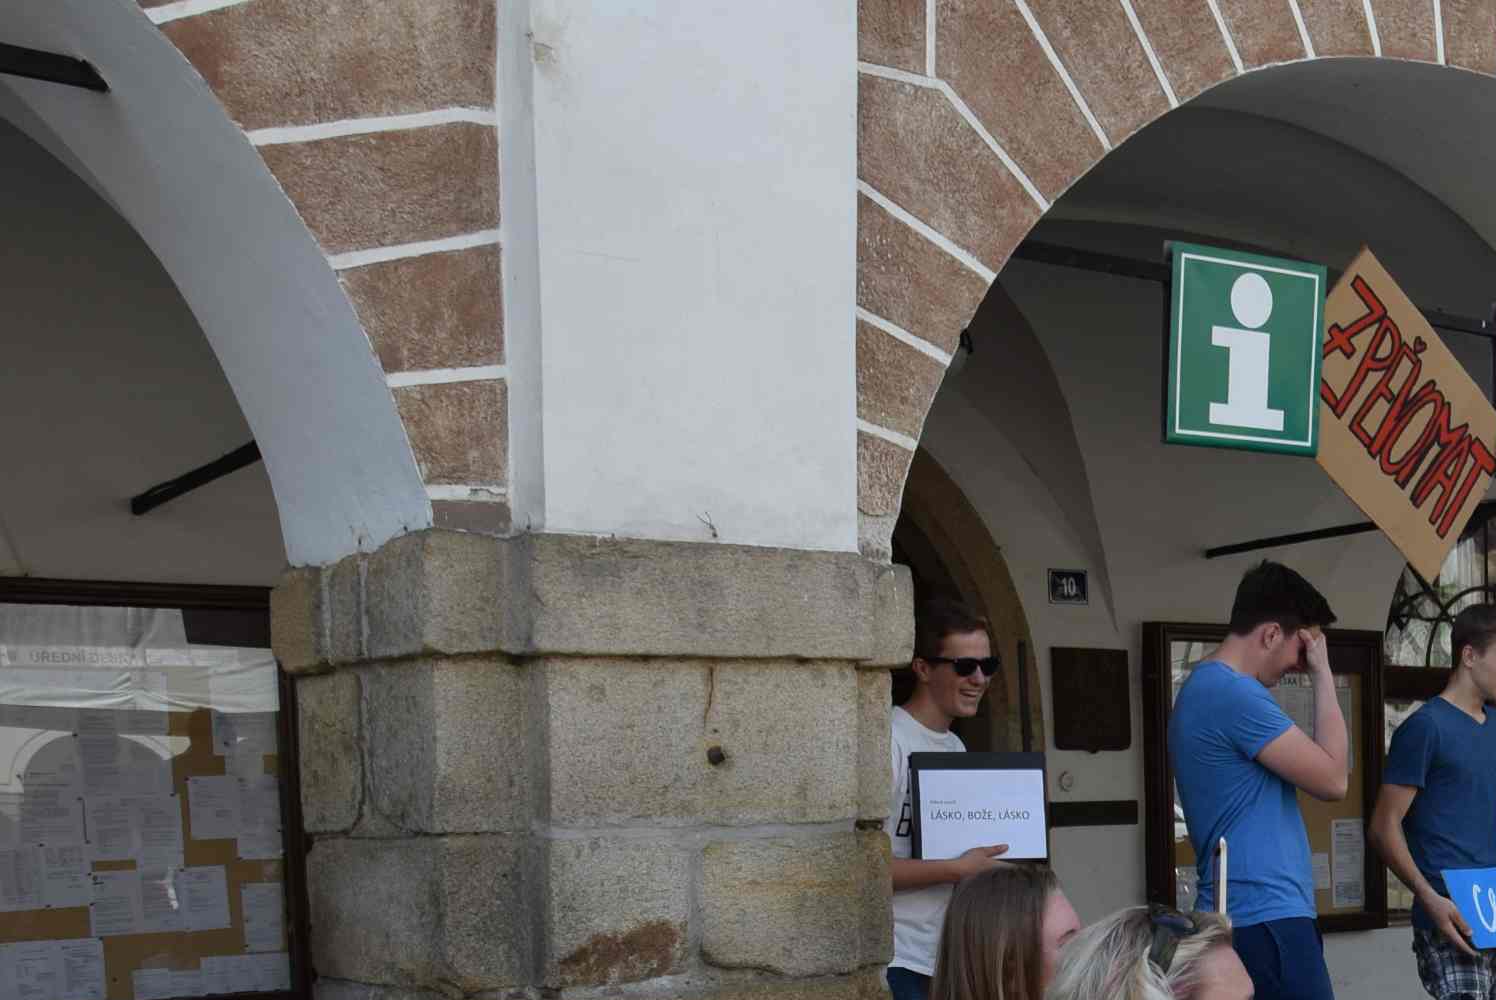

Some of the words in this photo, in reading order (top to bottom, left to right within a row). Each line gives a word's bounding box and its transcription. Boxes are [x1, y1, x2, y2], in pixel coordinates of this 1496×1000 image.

[1061, 576, 1077, 598] 10
[930, 807, 965, 822] LÁSKO,
[967, 807, 996, 822] BOŽE,
[998, 807, 1030, 821] LÁSKO
